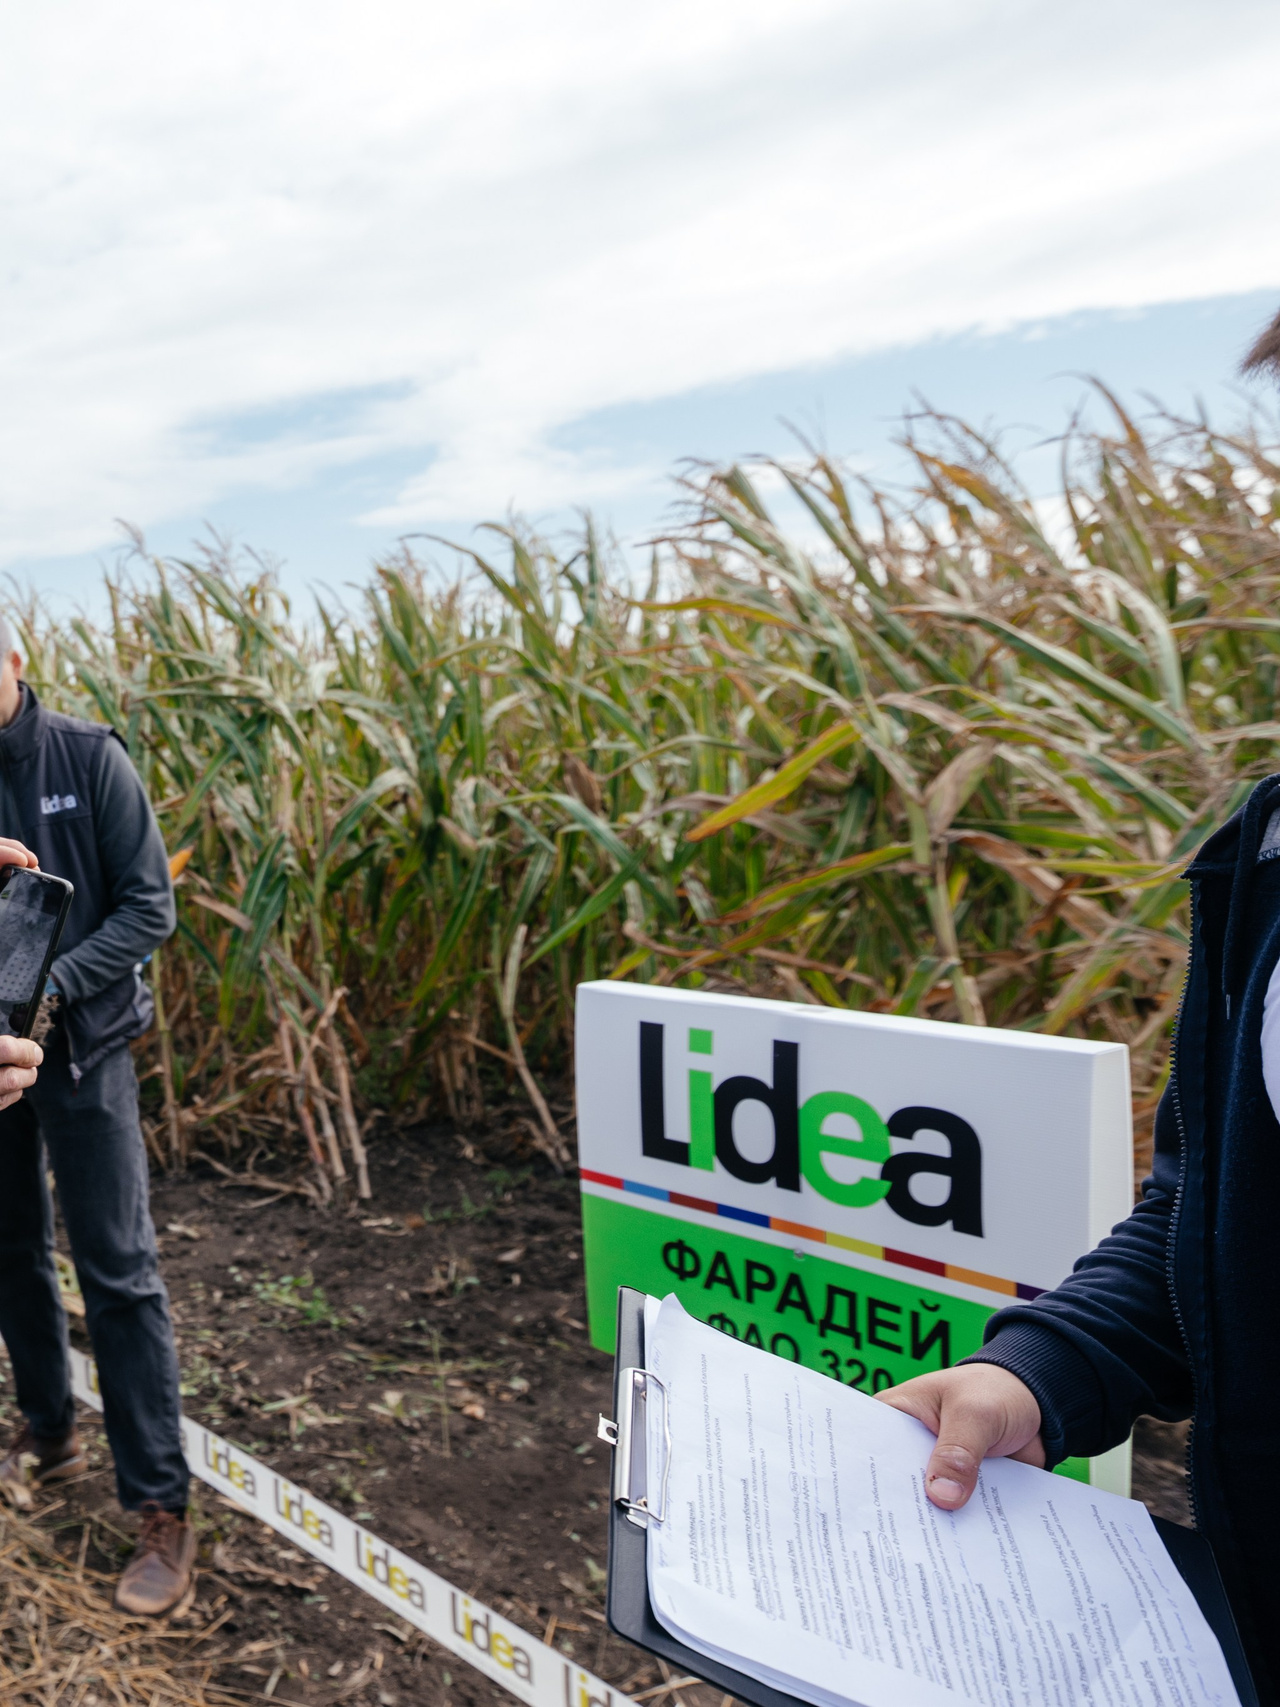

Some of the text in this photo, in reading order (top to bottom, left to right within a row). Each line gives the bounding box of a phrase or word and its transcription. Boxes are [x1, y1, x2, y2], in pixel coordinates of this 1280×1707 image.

[638, 1020, 985, 1239] Lidea
[661, 1238, 952, 1370] ФАРАДЕЙ
[203, 1432, 257, 1499] Lidea
[274, 1477, 334, 1551] Lidea
[355, 1528, 428, 1613] Lidea
[450, 1590, 535, 1686] Lidea
